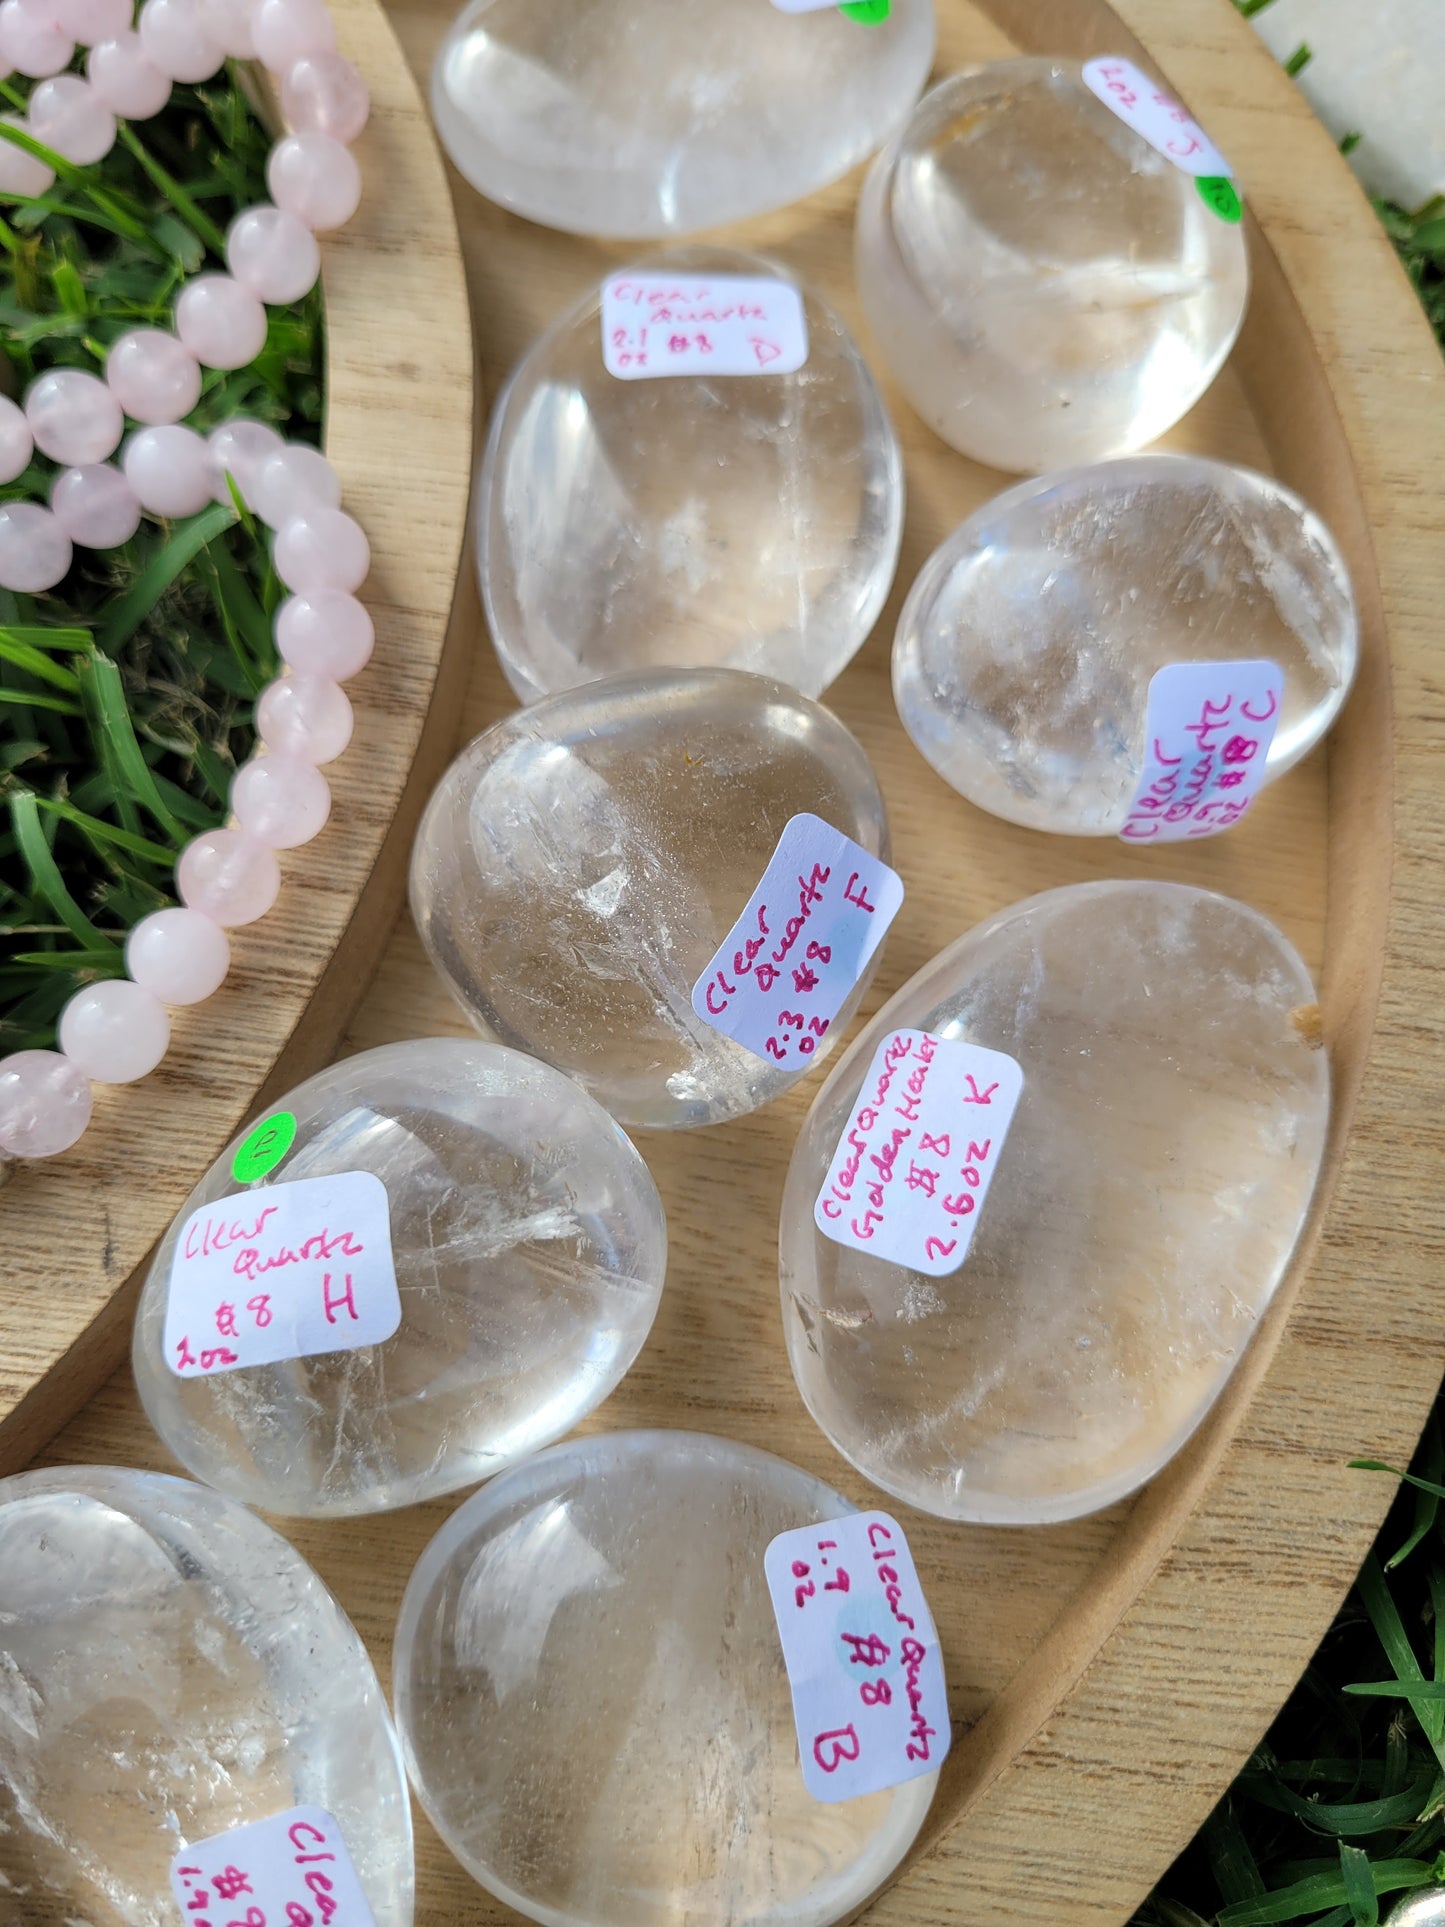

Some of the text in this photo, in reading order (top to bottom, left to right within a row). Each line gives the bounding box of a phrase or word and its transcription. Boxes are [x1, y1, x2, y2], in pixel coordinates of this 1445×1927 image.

[613, 282, 710, 305] Clear
[650, 305, 768, 324] Quartz
[612, 327, 648, 349] 2.1
[749, 337, 783, 367] D
[1240, 690, 1276, 721] C
[1120, 738, 1182, 838] Clear
[1163, 694, 1231, 823] Quartz
[1218, 797, 1249, 825] oz
[706, 904, 770, 1015] Clear
[754, 863, 831, 993] Quartz
[792, 872, 875, 993] $8 F
[765, 1010, 805, 1060] 2.3
[799, 1016, 830, 1054] oz
[822, 1035, 912, 1219] Clear Quartz
[904, 1073, 1000, 1198] $8 K
[851, 1128, 912, 1239] Golden
[185, 1206, 279, 1259] Clear
[232, 1228, 364, 1281] Quartz
[215, 1273, 359, 1337] $8 H
[791, 1559, 816, 1608] oz
[840, 1631, 892, 1706] $8
[867, 1522, 936, 1762] Clear Quartz
[813, 1722, 860, 1773] B
[288, 1821, 337, 1926] Clea
